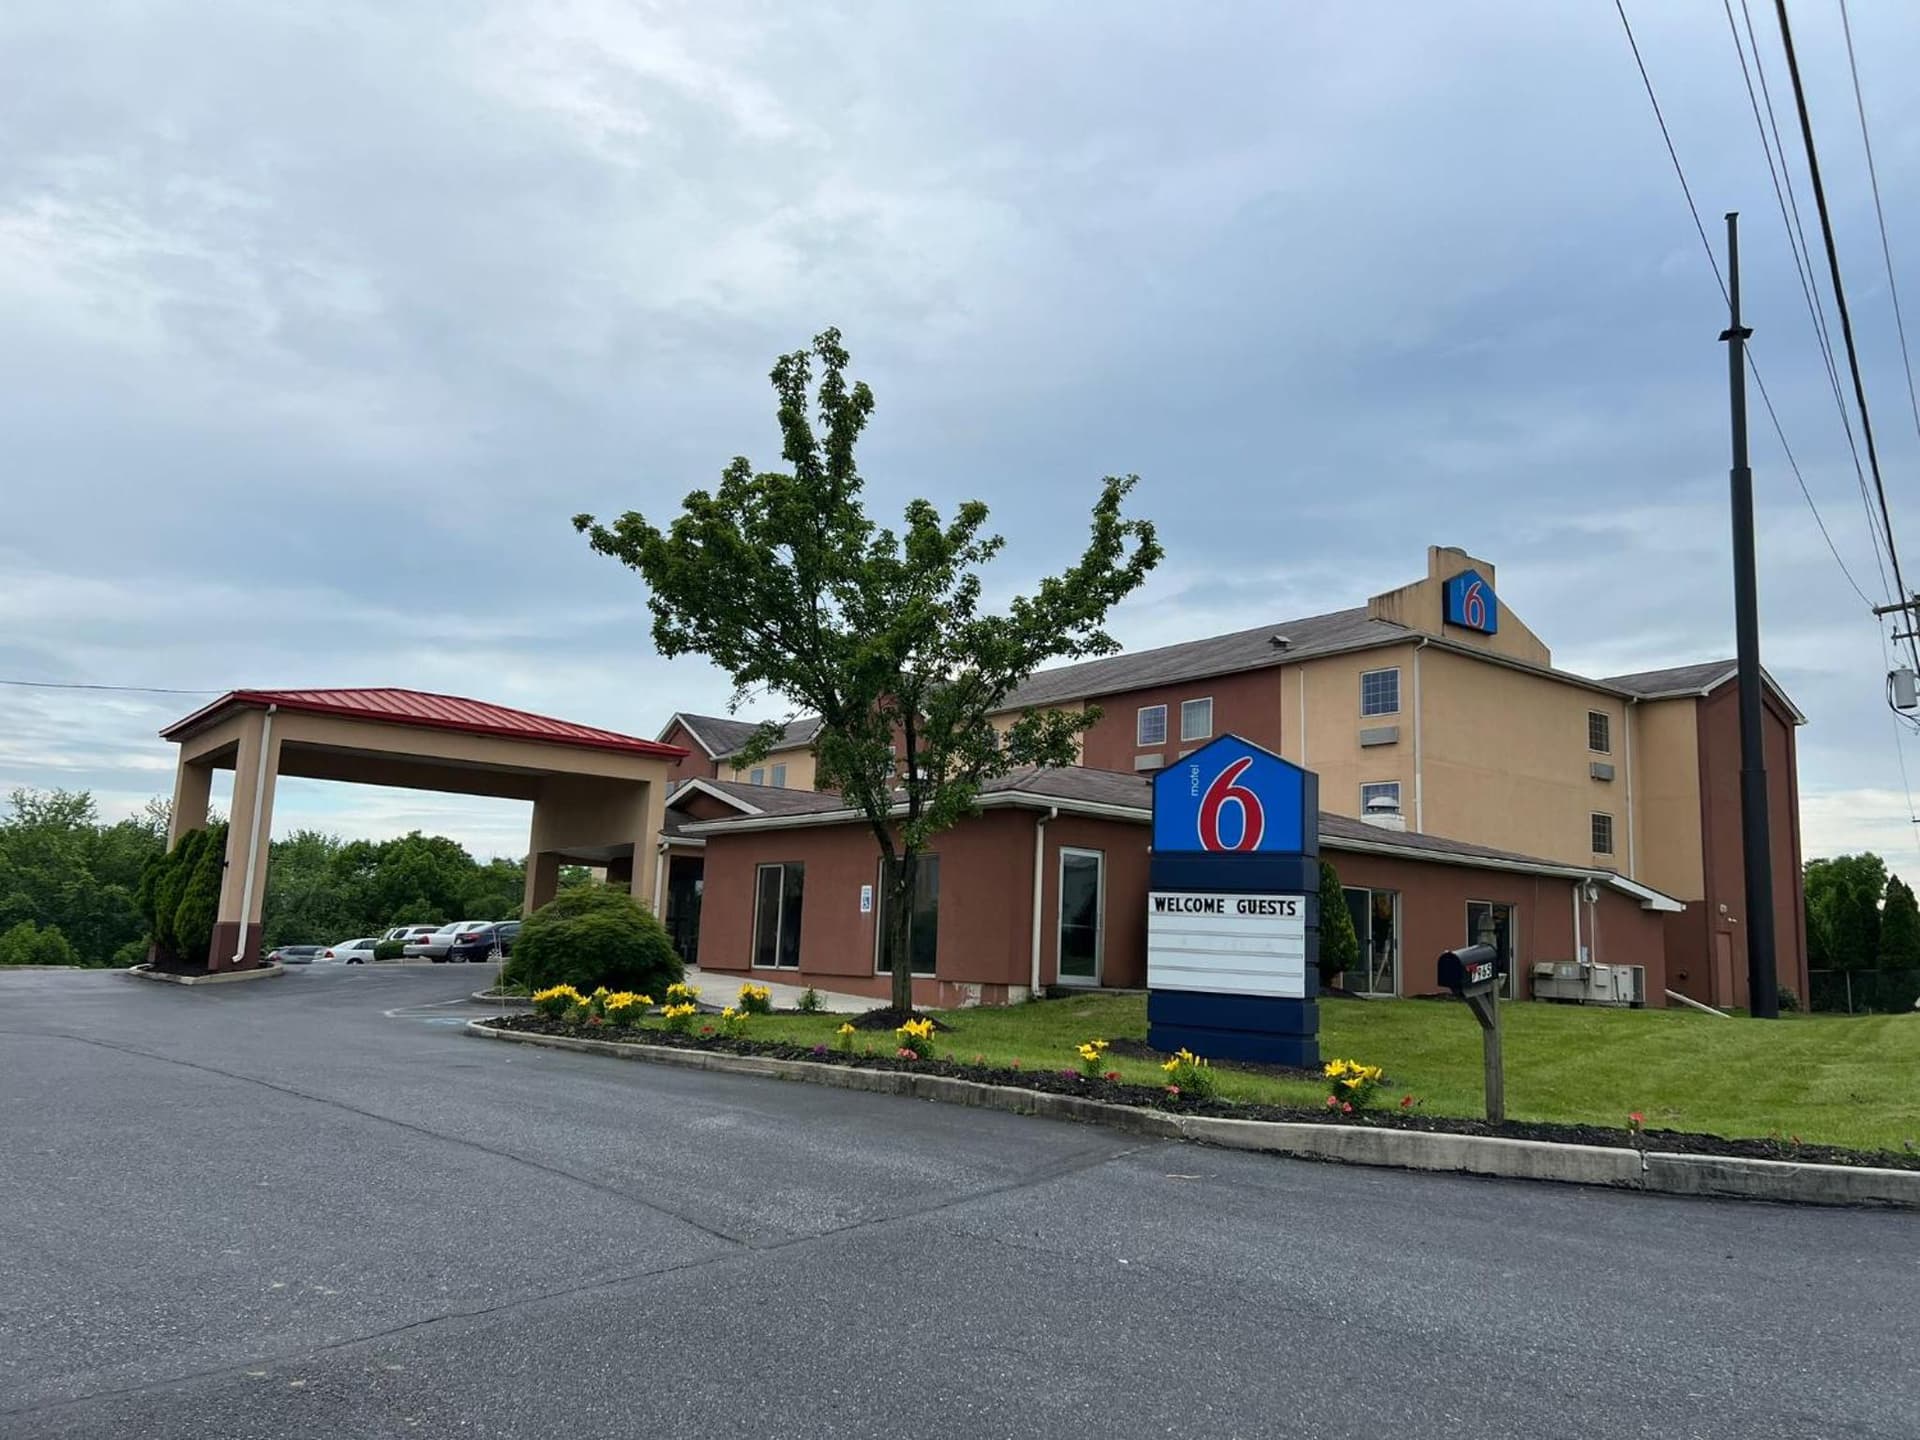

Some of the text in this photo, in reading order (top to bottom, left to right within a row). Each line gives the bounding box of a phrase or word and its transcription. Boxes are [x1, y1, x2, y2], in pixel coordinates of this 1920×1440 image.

[1463, 580, 1486, 629] 6
[1190, 764, 1199, 797] motel
[1197, 755, 1265, 852] 6
[1154, 897, 1296, 916] WELCOME GUESTS
